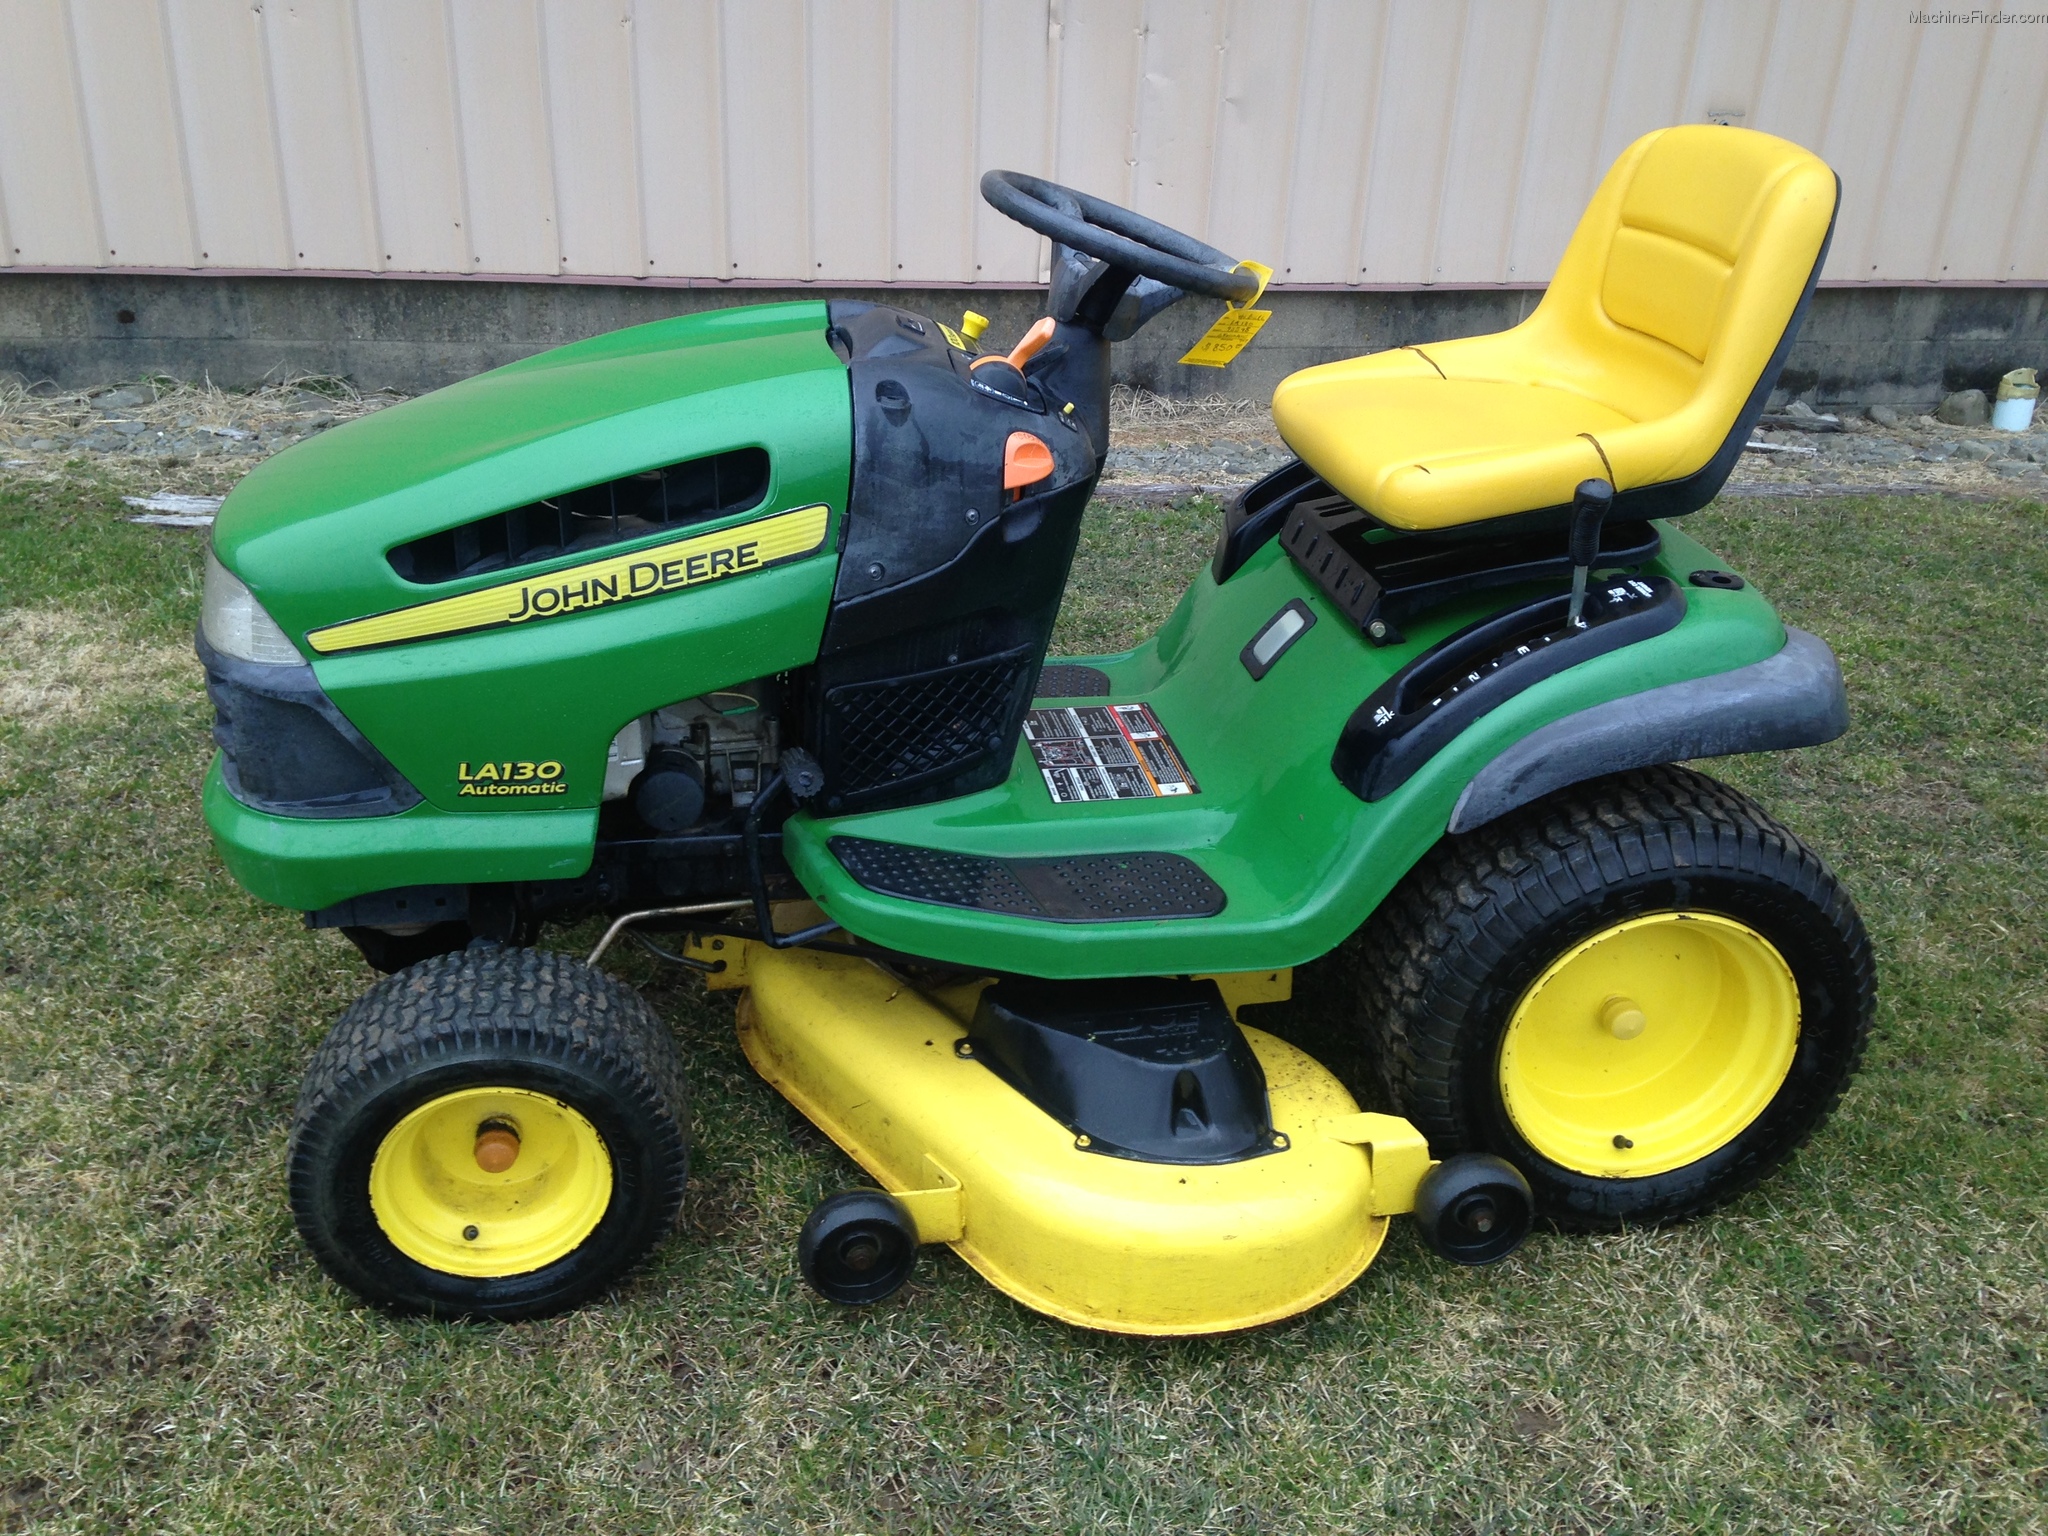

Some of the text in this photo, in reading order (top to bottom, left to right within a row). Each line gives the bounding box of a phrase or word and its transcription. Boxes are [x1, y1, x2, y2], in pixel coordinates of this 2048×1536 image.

[508, 541, 759, 619] JOHN DEERE
[458, 761, 563, 781] LA130
[459, 781, 567, 796] Automatic
